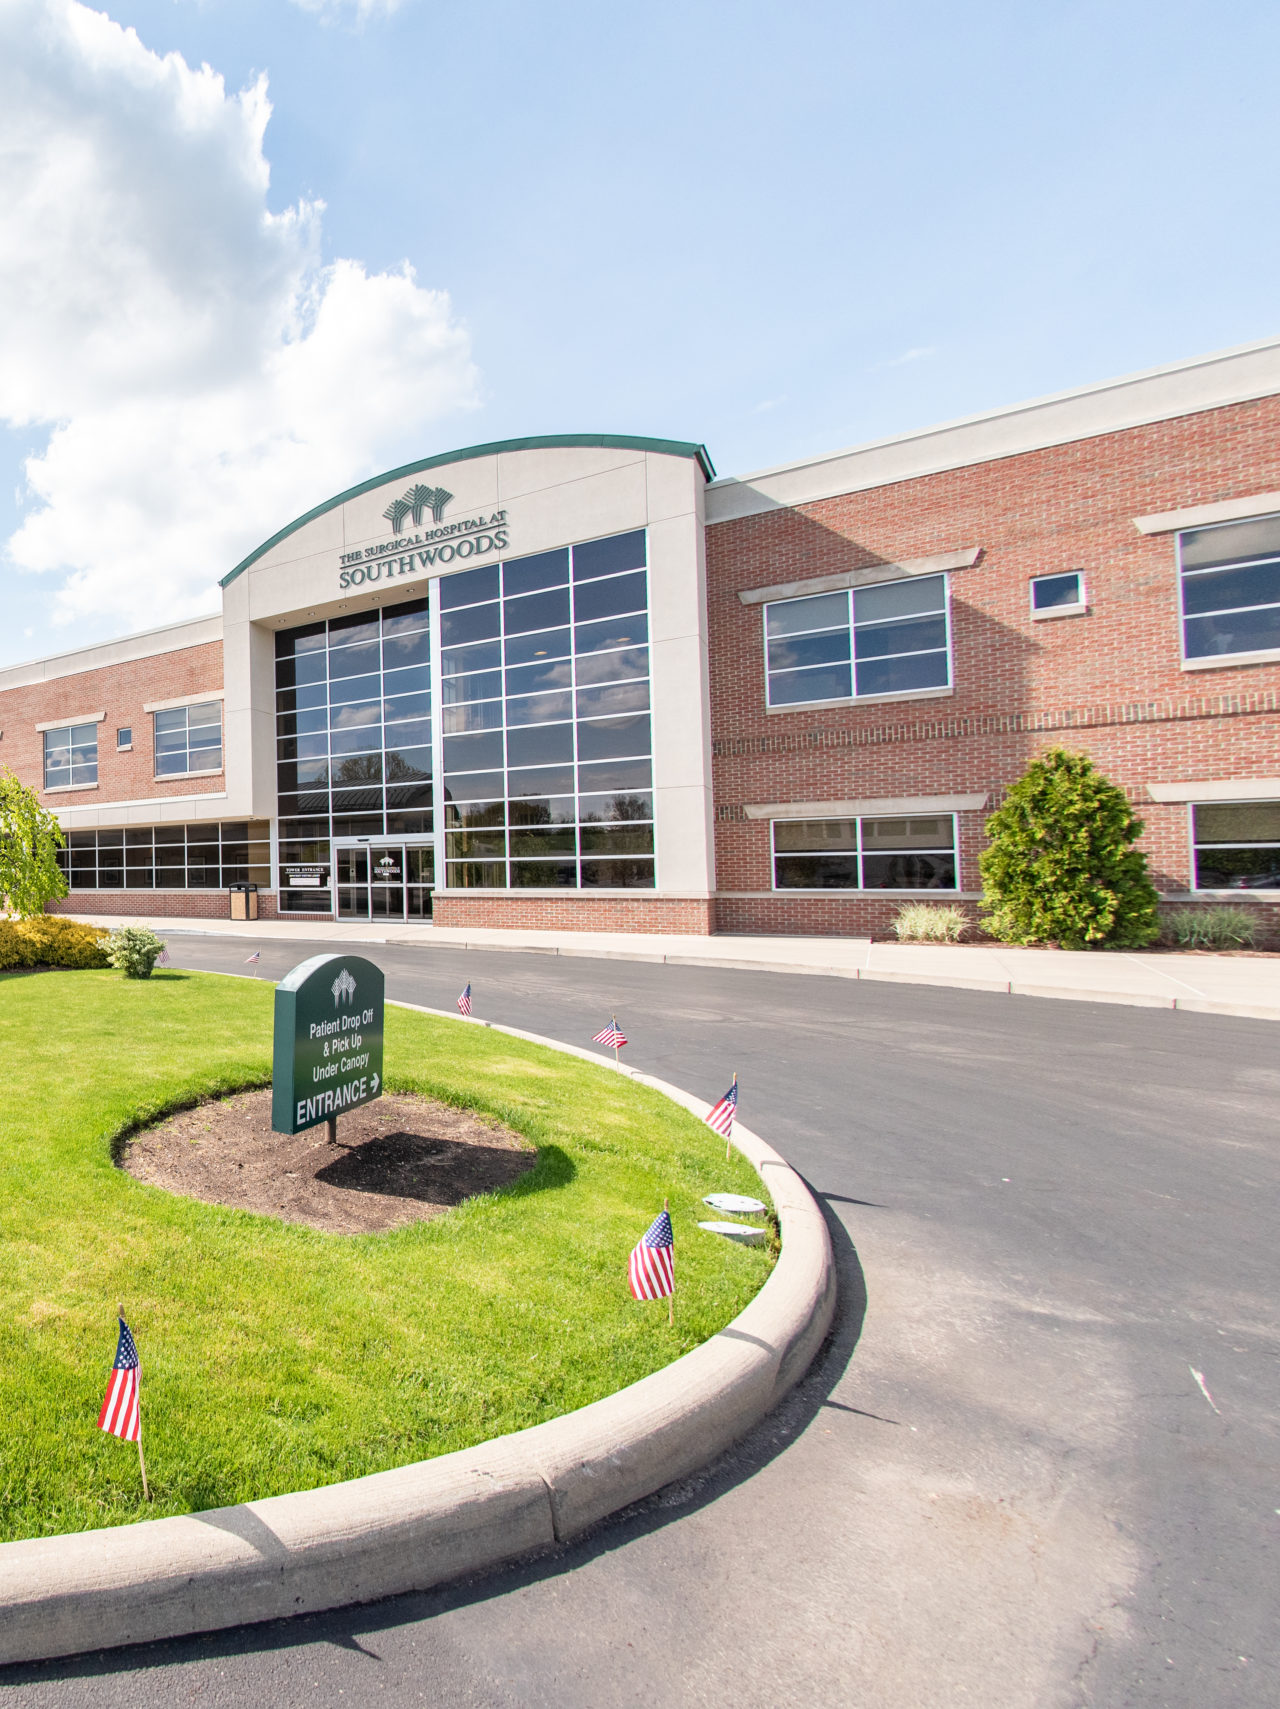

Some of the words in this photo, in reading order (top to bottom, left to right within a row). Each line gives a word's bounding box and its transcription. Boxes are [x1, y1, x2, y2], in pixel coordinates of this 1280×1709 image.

[339, 550, 362, 565] THE
[364, 534, 421, 558] SURGICAL
[425, 516, 487, 542] HOSPITAL
[489, 510, 508, 523] AT
[339, 530, 509, 589] SOUTHWOODS
[310, 1018, 340, 1040] Patient
[342, 1015, 361, 1031] Drop
[362, 1008, 373, 1023] Off
[323, 1042, 329, 1056] &
[332, 1038, 349, 1054] Pick
[351, 1033, 362, 1050] Up
[313, 1062, 338, 1082] Under
[340, 1053, 369, 1072] Canopy
[297, 1077, 367, 1125] ENTRANCE
